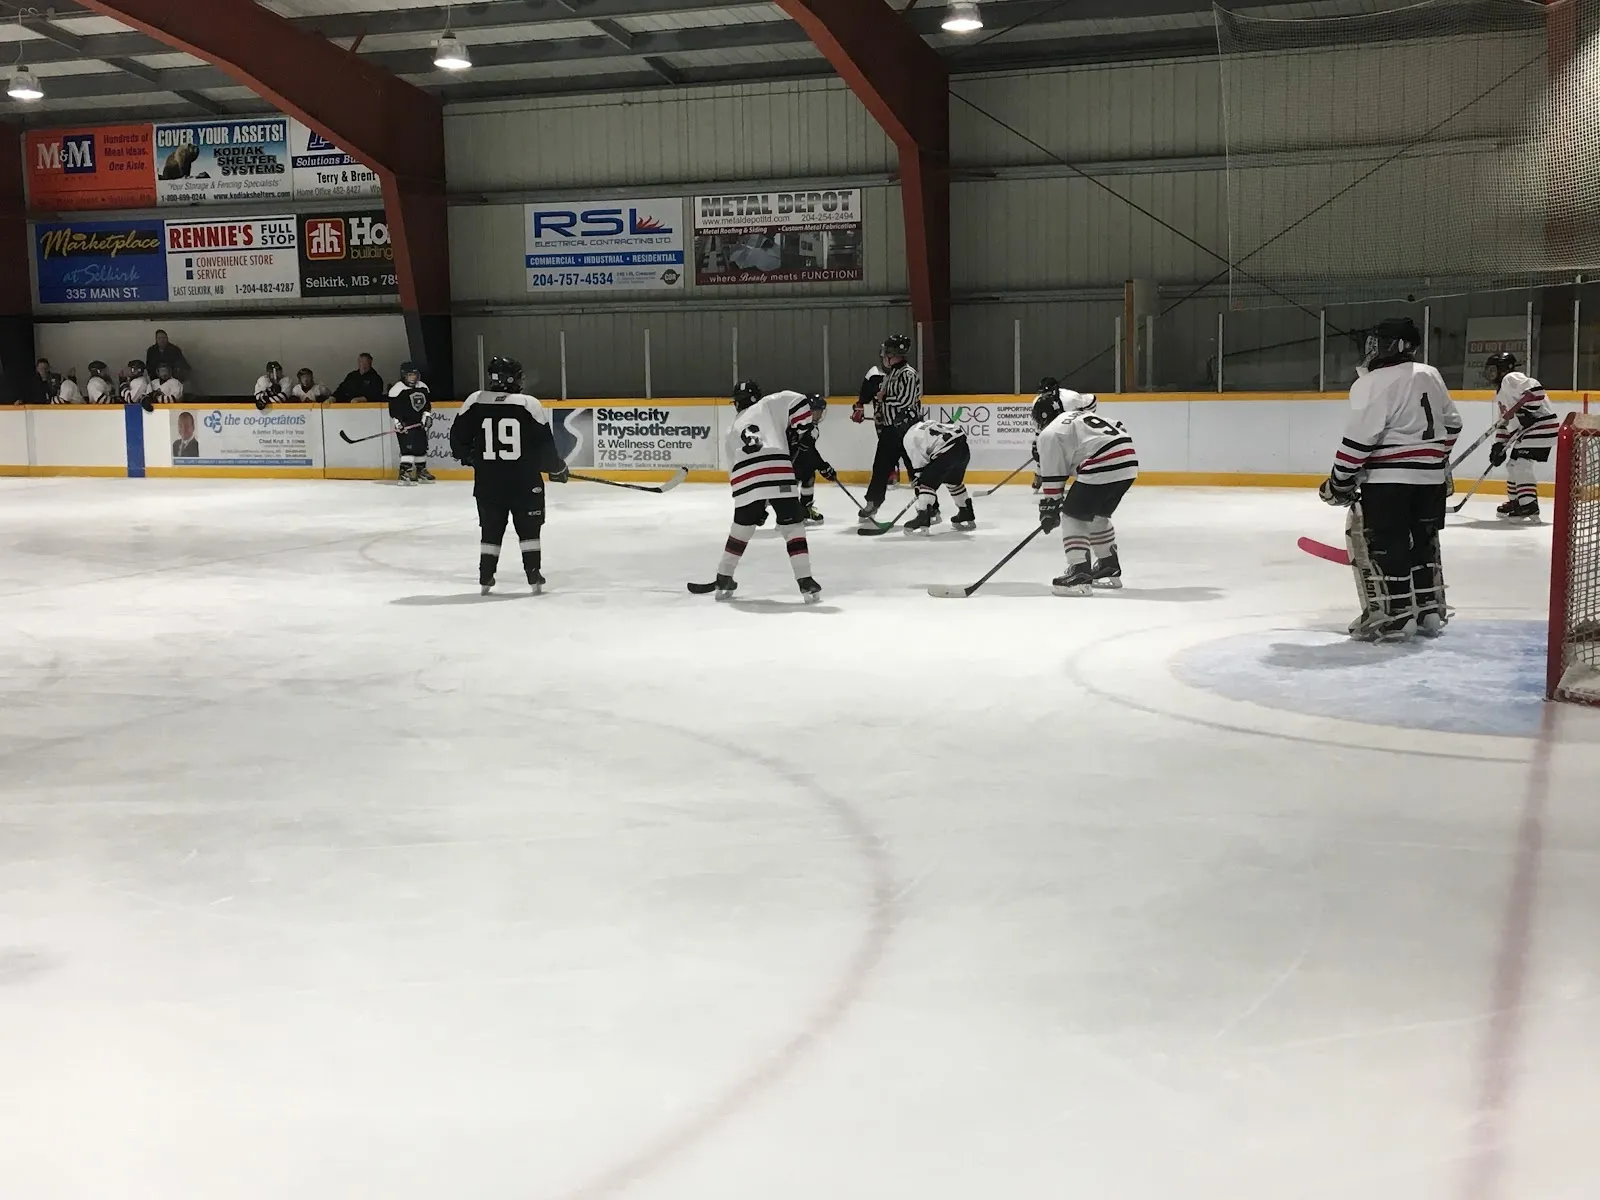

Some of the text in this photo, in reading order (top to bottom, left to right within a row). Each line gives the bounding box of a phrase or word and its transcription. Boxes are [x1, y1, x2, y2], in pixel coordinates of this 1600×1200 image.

[157, 124, 284, 147] COVER YOUR ASSETS!
[37, 140, 93, 170] M&M
[213, 146, 264, 158] KODIAK
[109, 161, 124, 171] One
[217, 155, 277, 167] SHELTER
[296, 156, 340, 167] Solutions
[221, 164, 285, 176] SYSTEMS
[317, 170, 376, 185] Terry & Brent
[185, 181, 209, 191] Storage
[217, 180, 242, 190] Fencing
[296, 187, 314, 196] Home
[314, 186, 331, 196] Office
[701, 190, 853, 217] METAL DEPOT
[533, 208, 673, 238] RSL
[801, 212, 854, 222] 204-254-2494
[719, 227, 743, 236] Roofing
[749, 226, 768, 235] Siding
[781, 224, 804, 232] Custom
[804, 223, 823, 231] Metal
[822, 222, 857, 230] Fabrication
[169, 223, 292, 249] RENNIE'S FULL
[261, 233, 296, 246] STOP
[534, 236, 672, 248] ELECTRICAL CONTRACTING LTD.
[40, 227, 161, 260] Marketplace
[350, 246, 394, 260] building
[530, 253, 677, 266] COMMERCIAL INDUSTRIAL RESIDENTIAL
[196, 254, 274, 268] CONVENIENCE STORE
[196, 268, 227, 280] SERVICE
[532, 272, 614, 287] 204-757-4534
[801, 270, 858, 280] FUNCTION!
[305, 275, 349, 288] Selkirk,
[351, 275, 370, 286] MB
[66, 287, 140, 300] 335 MAIN ST.
[173, 282, 295, 297] EAST SELKIRK, MB 1-204-482-4287
[224, 413, 306, 427] the co-operators
[597, 408, 669, 424] Steelcity
[1420, 392, 1435, 441] 1
[597, 423, 711, 440] Physiotherapy
[481, 418, 521, 461] 19
[597, 440, 692, 449] & Wellness Centre
[599, 450, 672, 461] 785-2888
